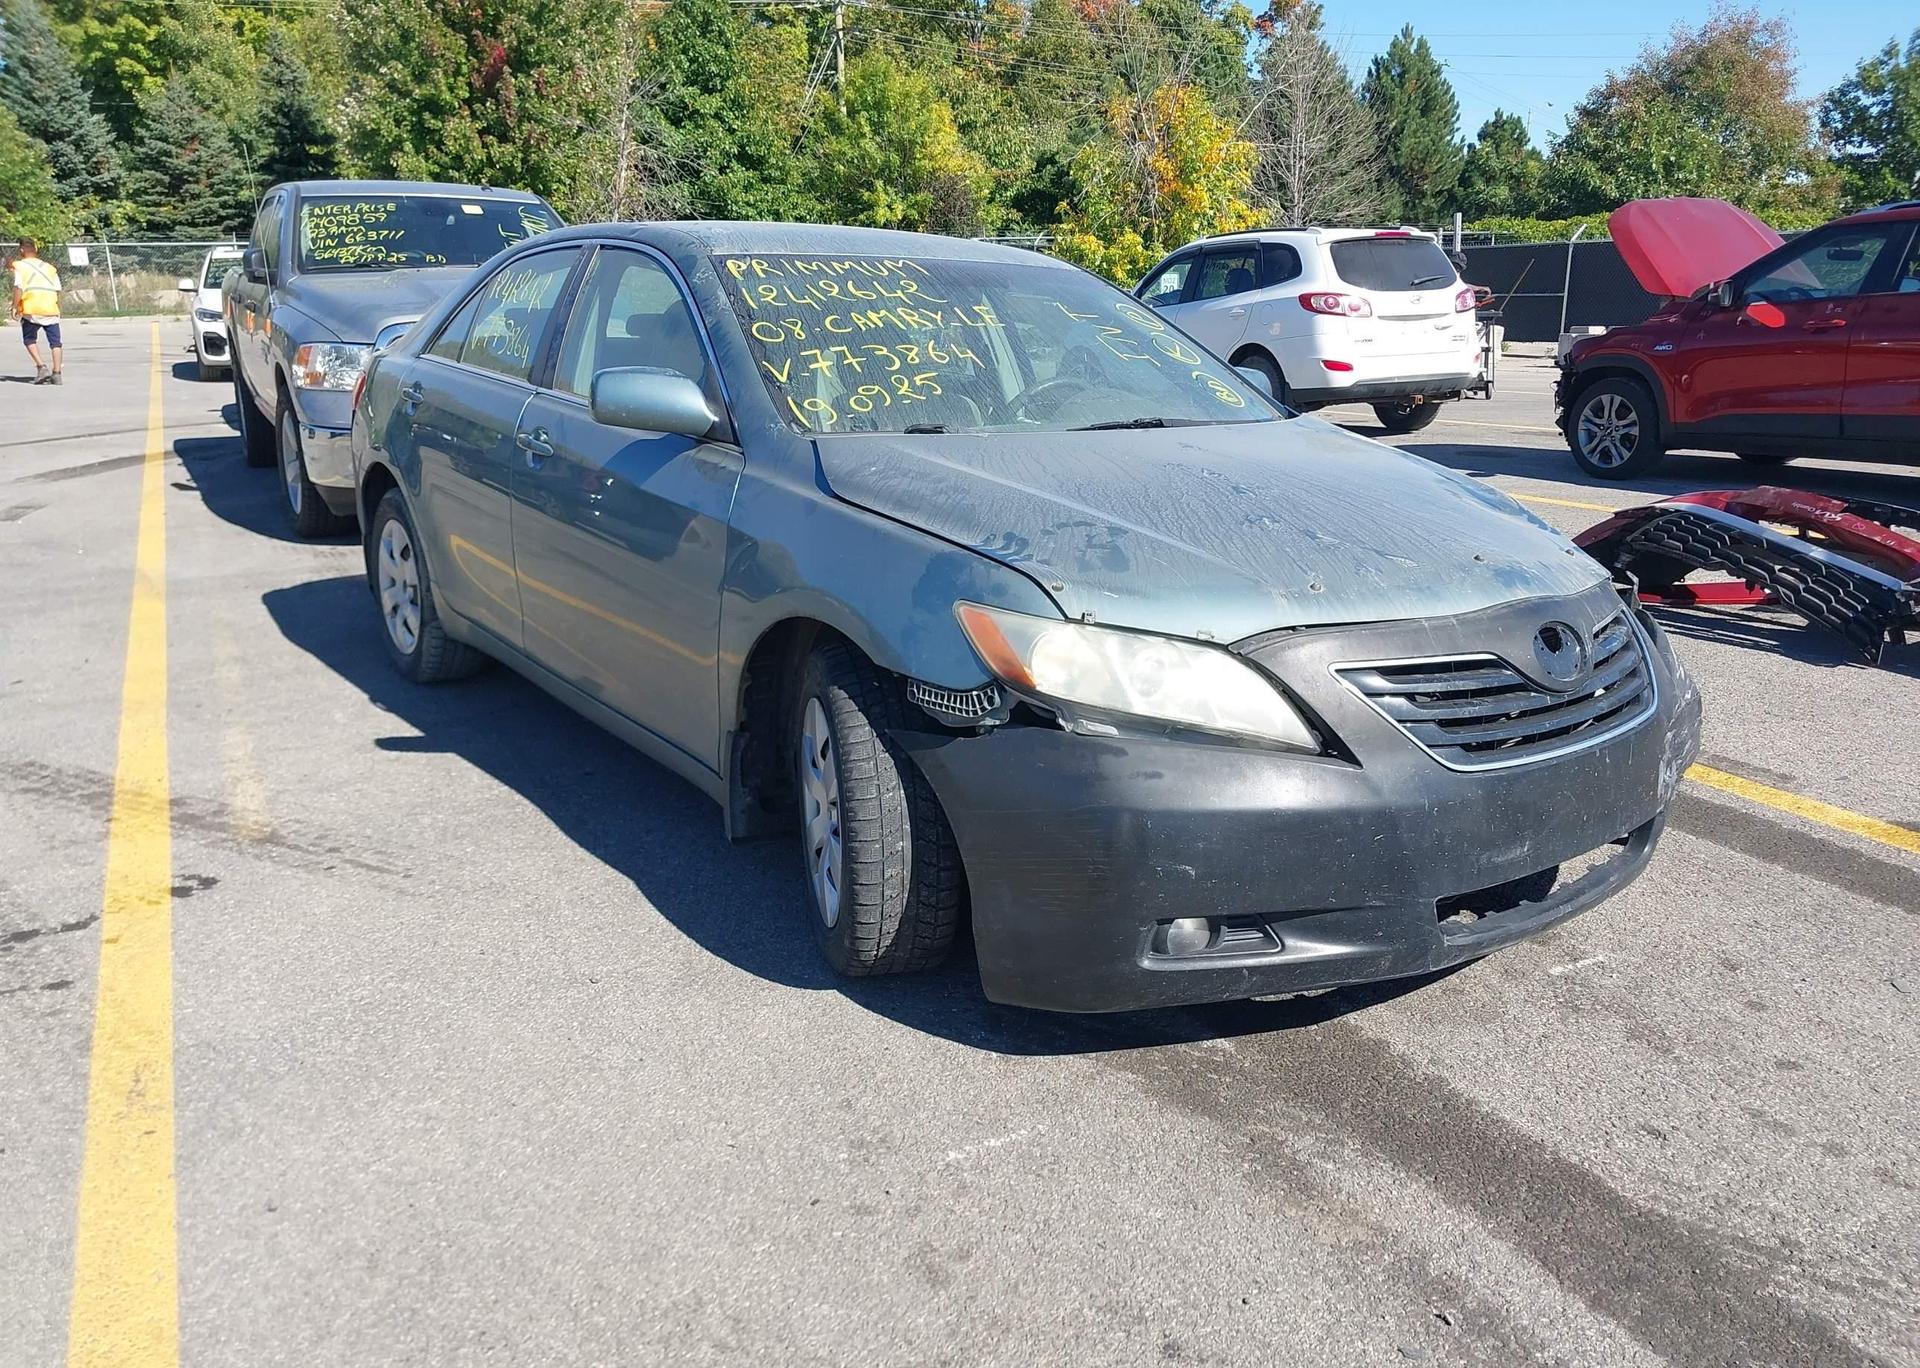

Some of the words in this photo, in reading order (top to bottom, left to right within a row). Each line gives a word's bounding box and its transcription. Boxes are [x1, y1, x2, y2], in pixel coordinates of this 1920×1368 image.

[308, 237, 338, 250] VIN
[725, 258, 930, 281] PRIMMUM
[741, 279, 948, 311] 12412642
